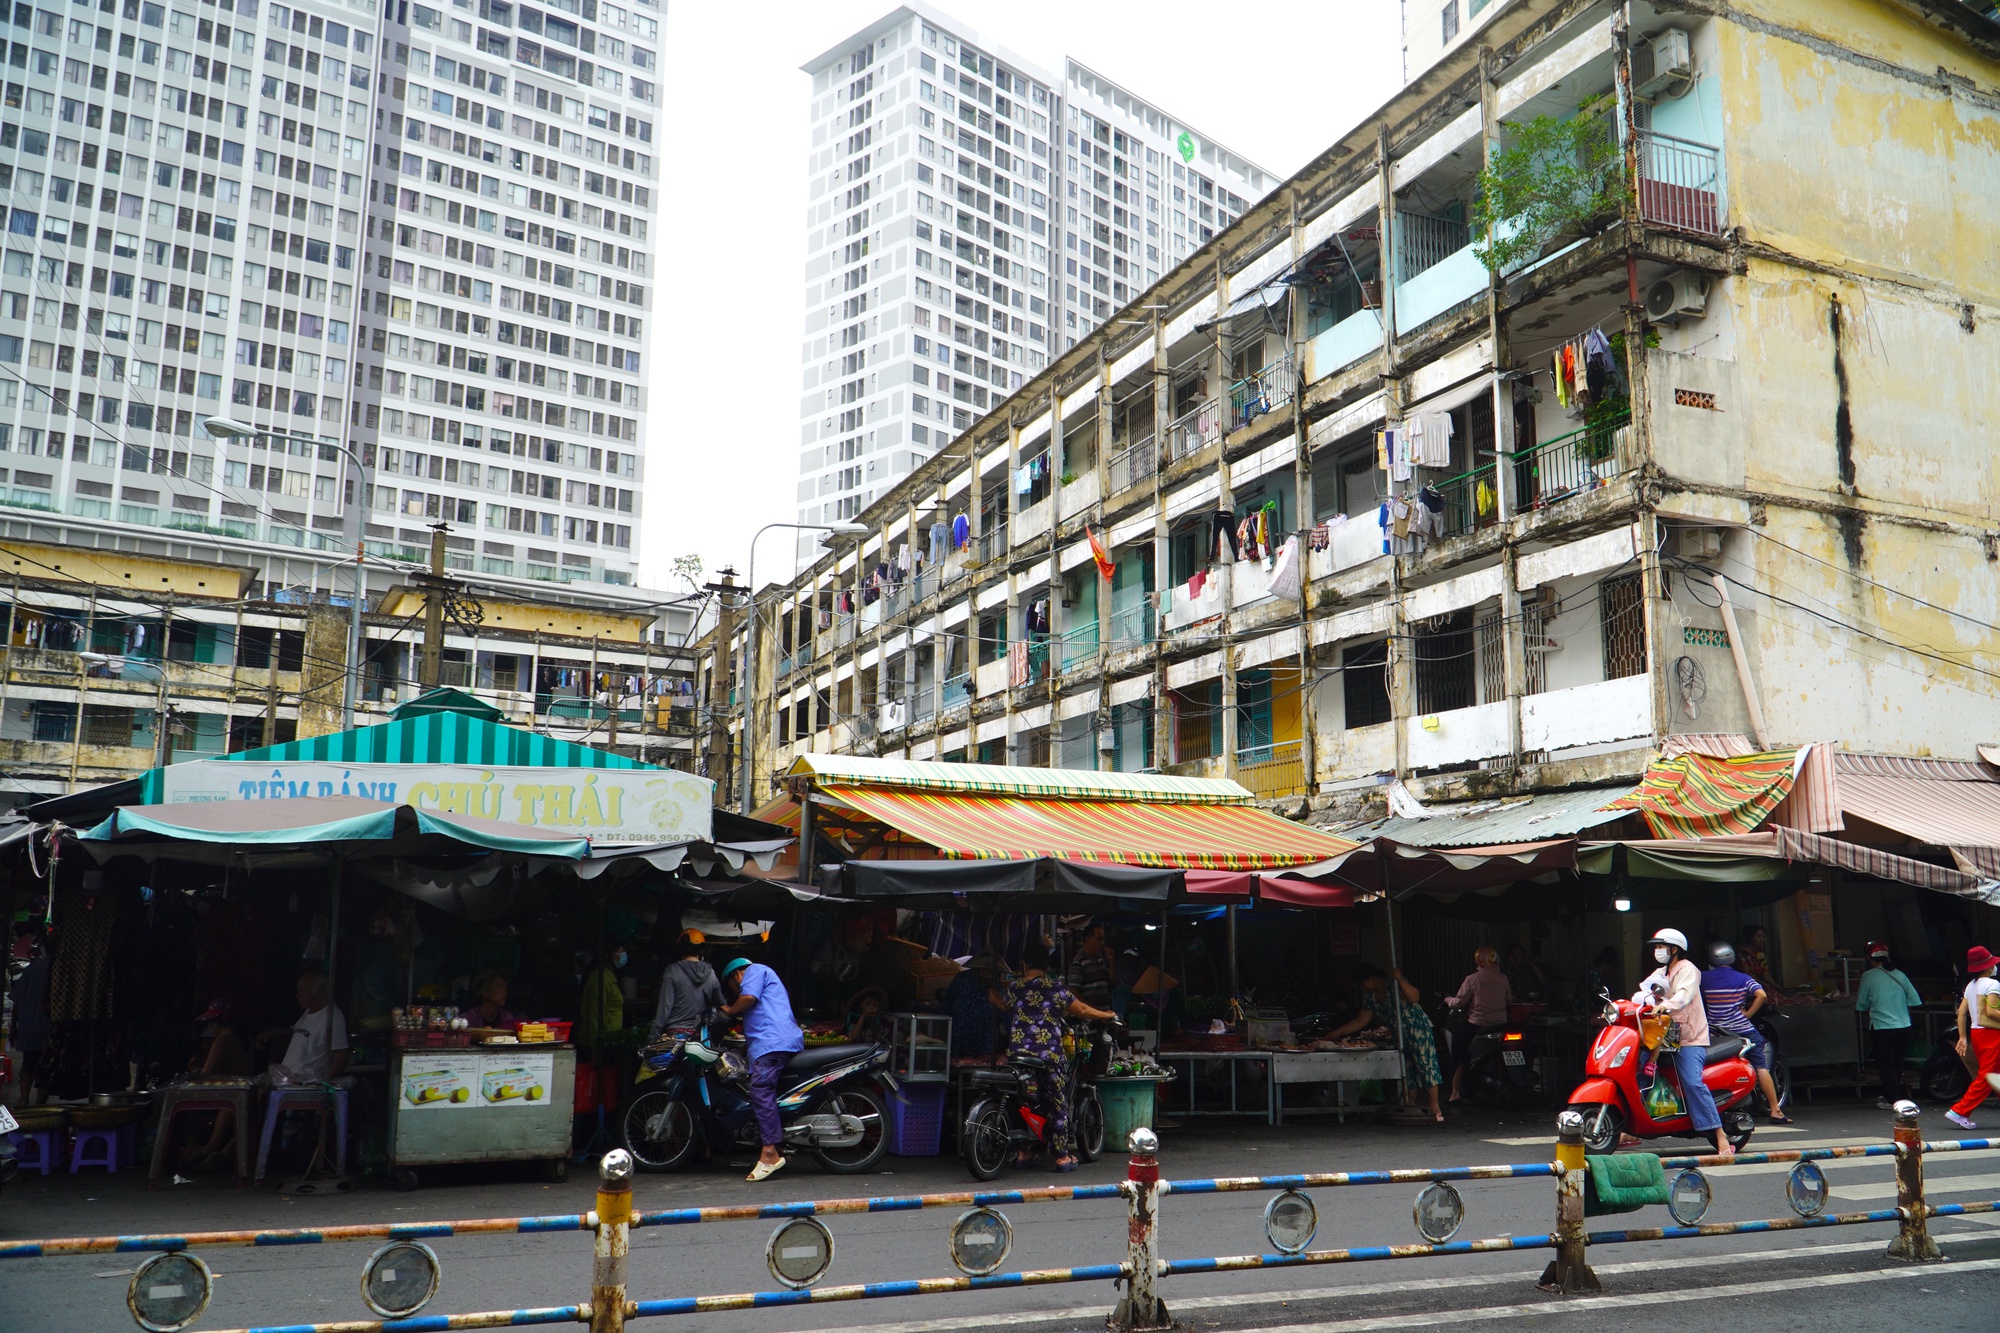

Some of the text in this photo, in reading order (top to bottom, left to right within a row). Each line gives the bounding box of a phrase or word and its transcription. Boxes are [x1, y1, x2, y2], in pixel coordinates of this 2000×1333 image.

[317, 770, 397, 803] BÁNH
[407, 771, 504, 820] CHÚ
[513, 774, 624, 827] THÁI
